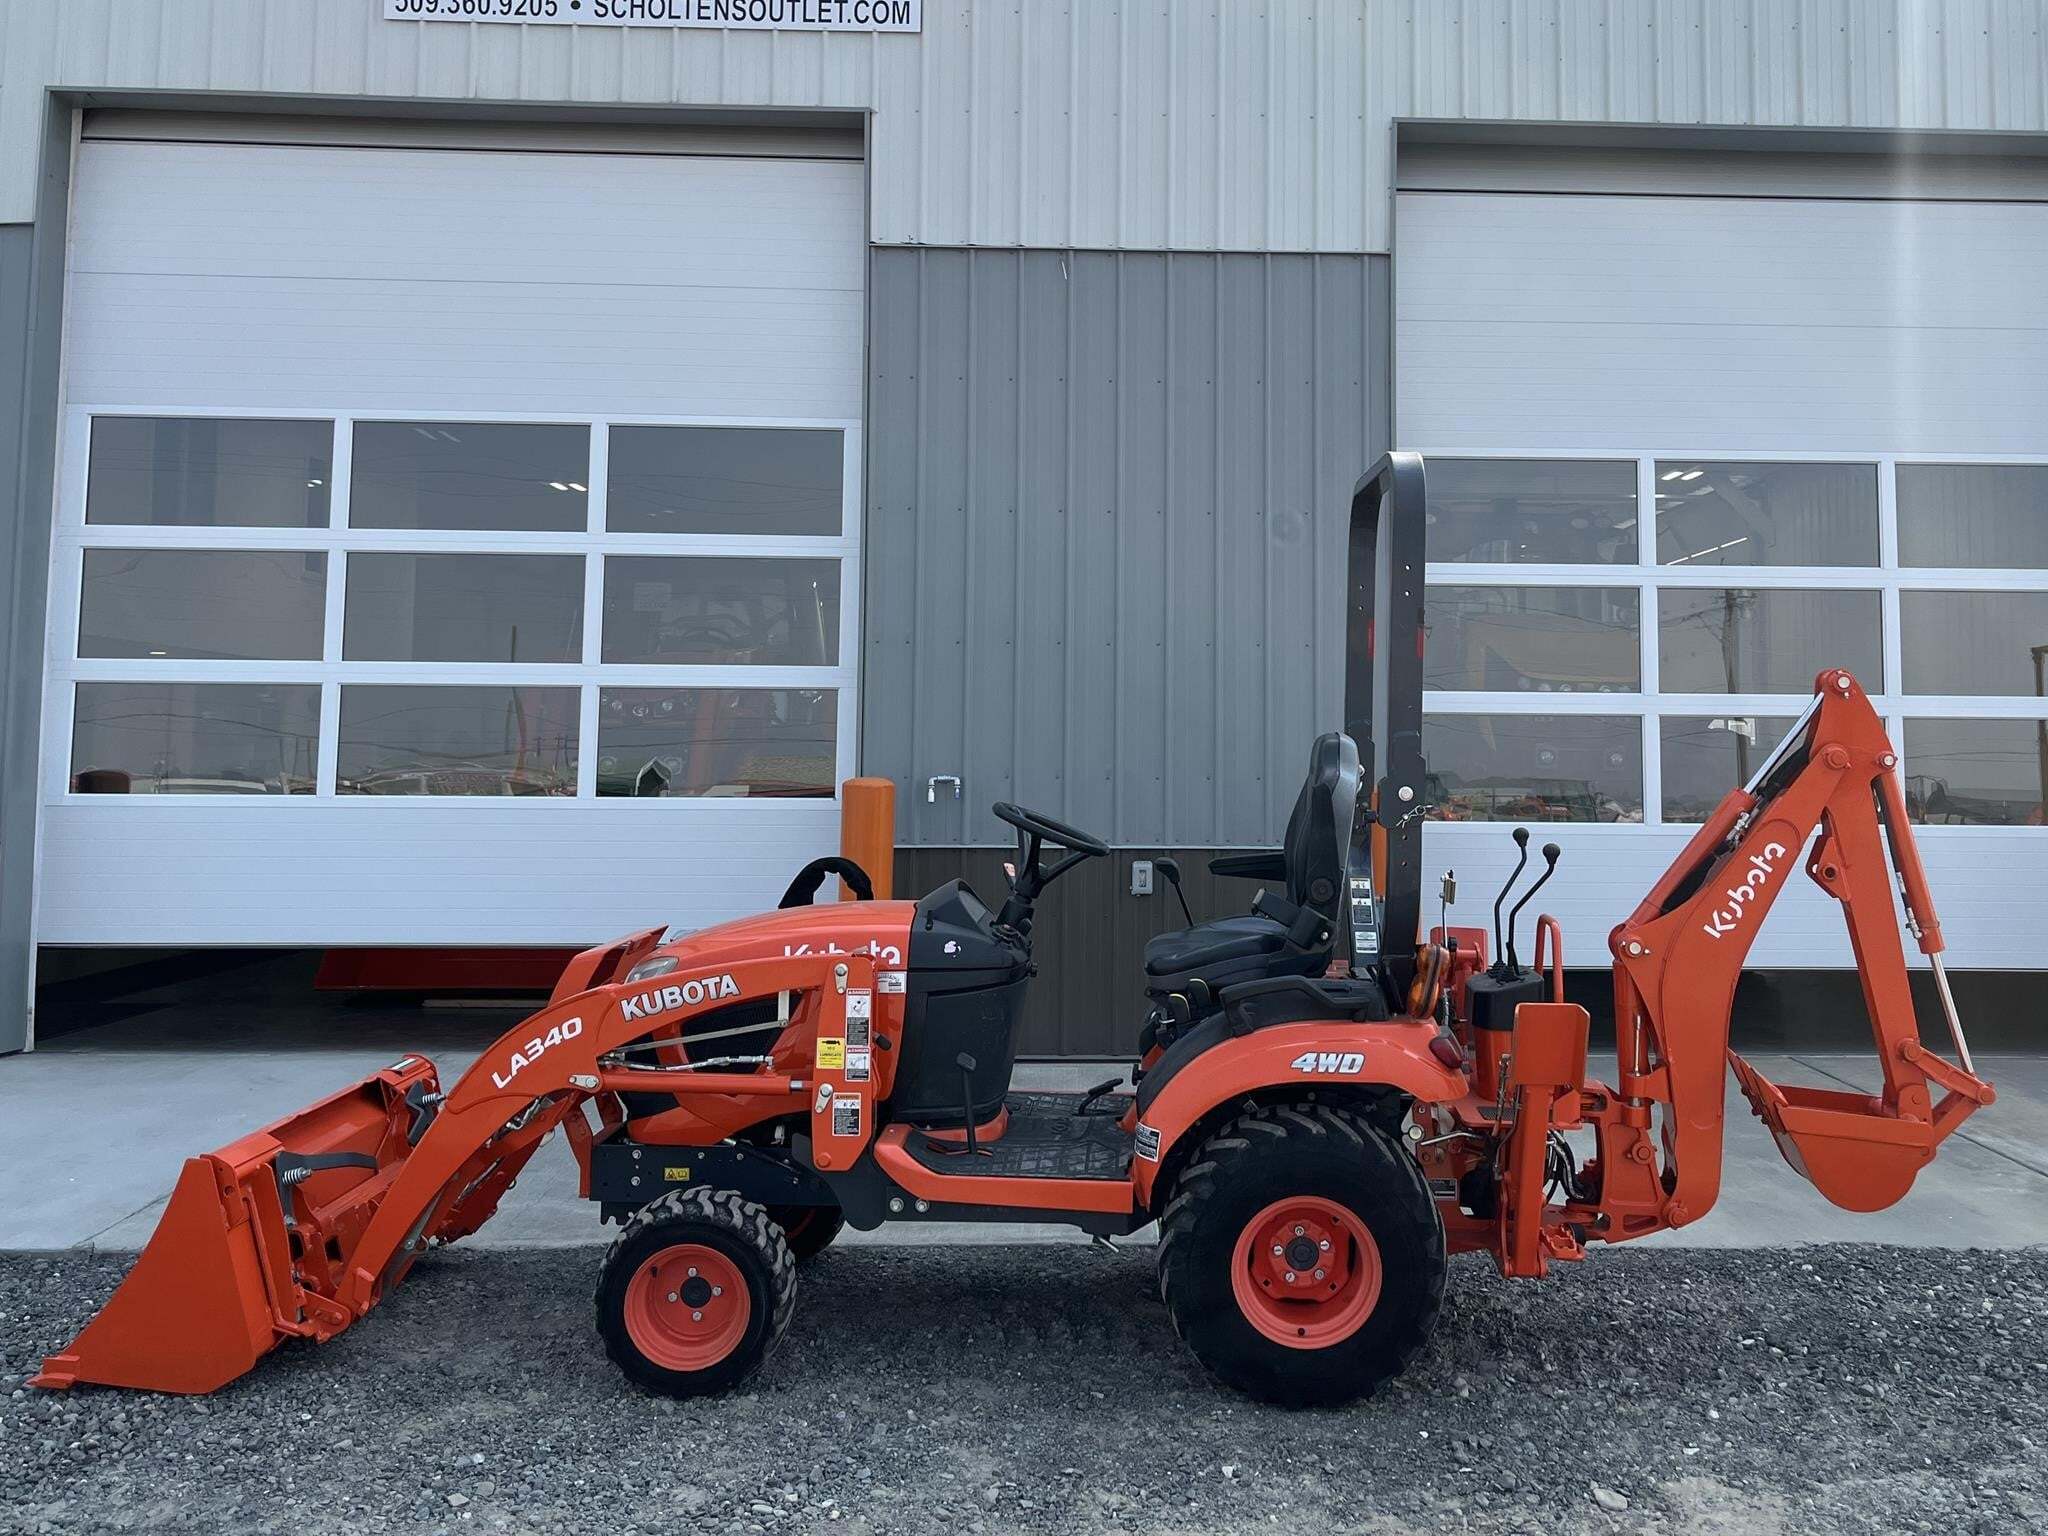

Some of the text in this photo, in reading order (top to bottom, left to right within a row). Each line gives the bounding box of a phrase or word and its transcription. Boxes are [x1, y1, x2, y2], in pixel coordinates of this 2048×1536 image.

[593, 0, 911, 24] SCHOLTENSOUTLET.COM
[1702, 842, 1787, 939] Kubota
[620, 973, 741, 1023] KUBOTA
[491, 1016, 583, 1089] LA340
[1290, 1052, 1365, 1074] 4WD
